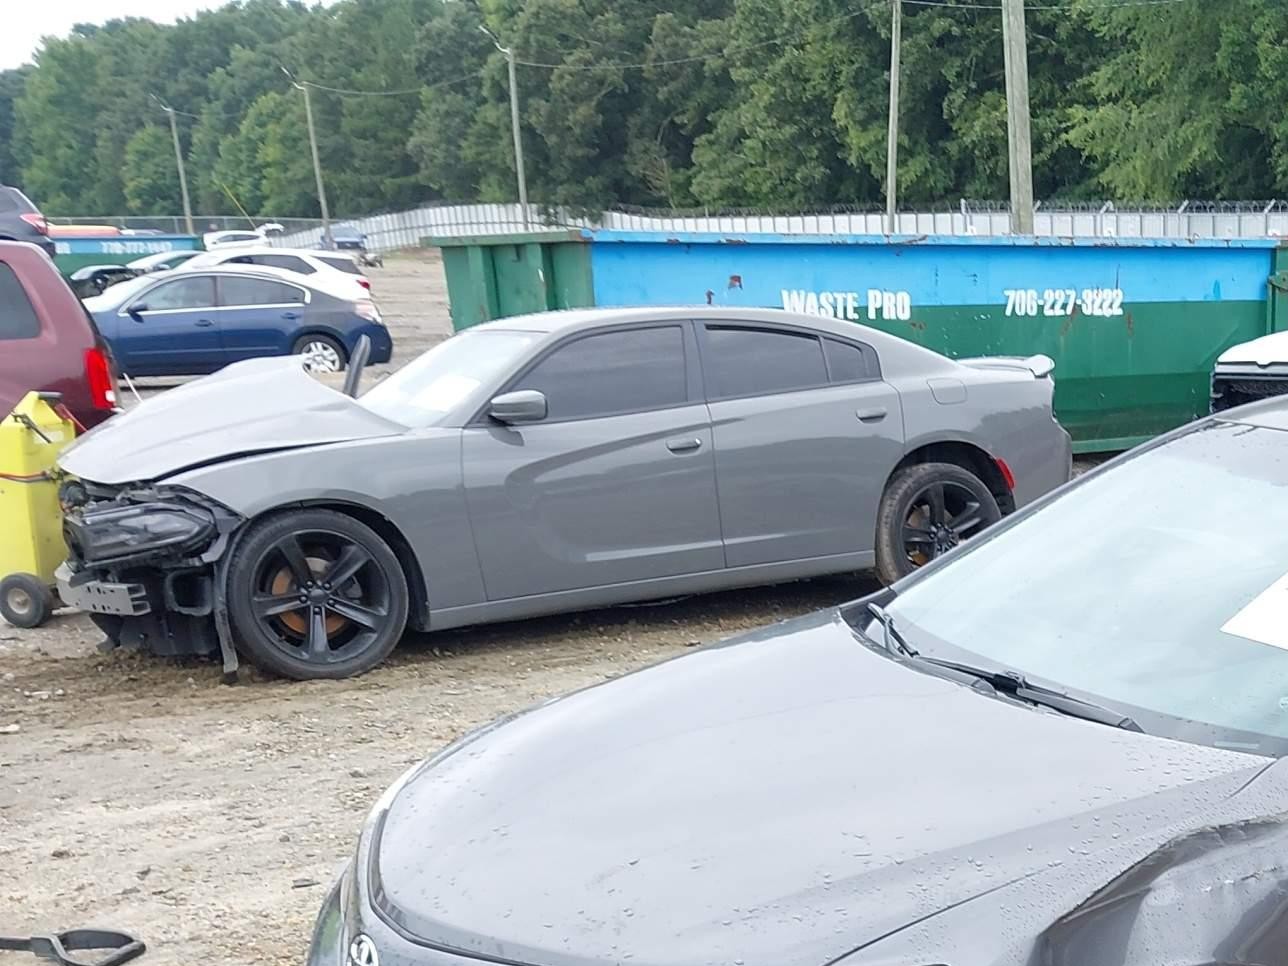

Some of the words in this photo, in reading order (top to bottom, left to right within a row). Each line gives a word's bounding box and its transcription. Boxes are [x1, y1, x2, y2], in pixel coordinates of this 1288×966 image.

[780, 288, 860, 320] WASTE
[866, 287, 912, 321] PRO
[1002, 288, 1124, 317] 706-227-3222
